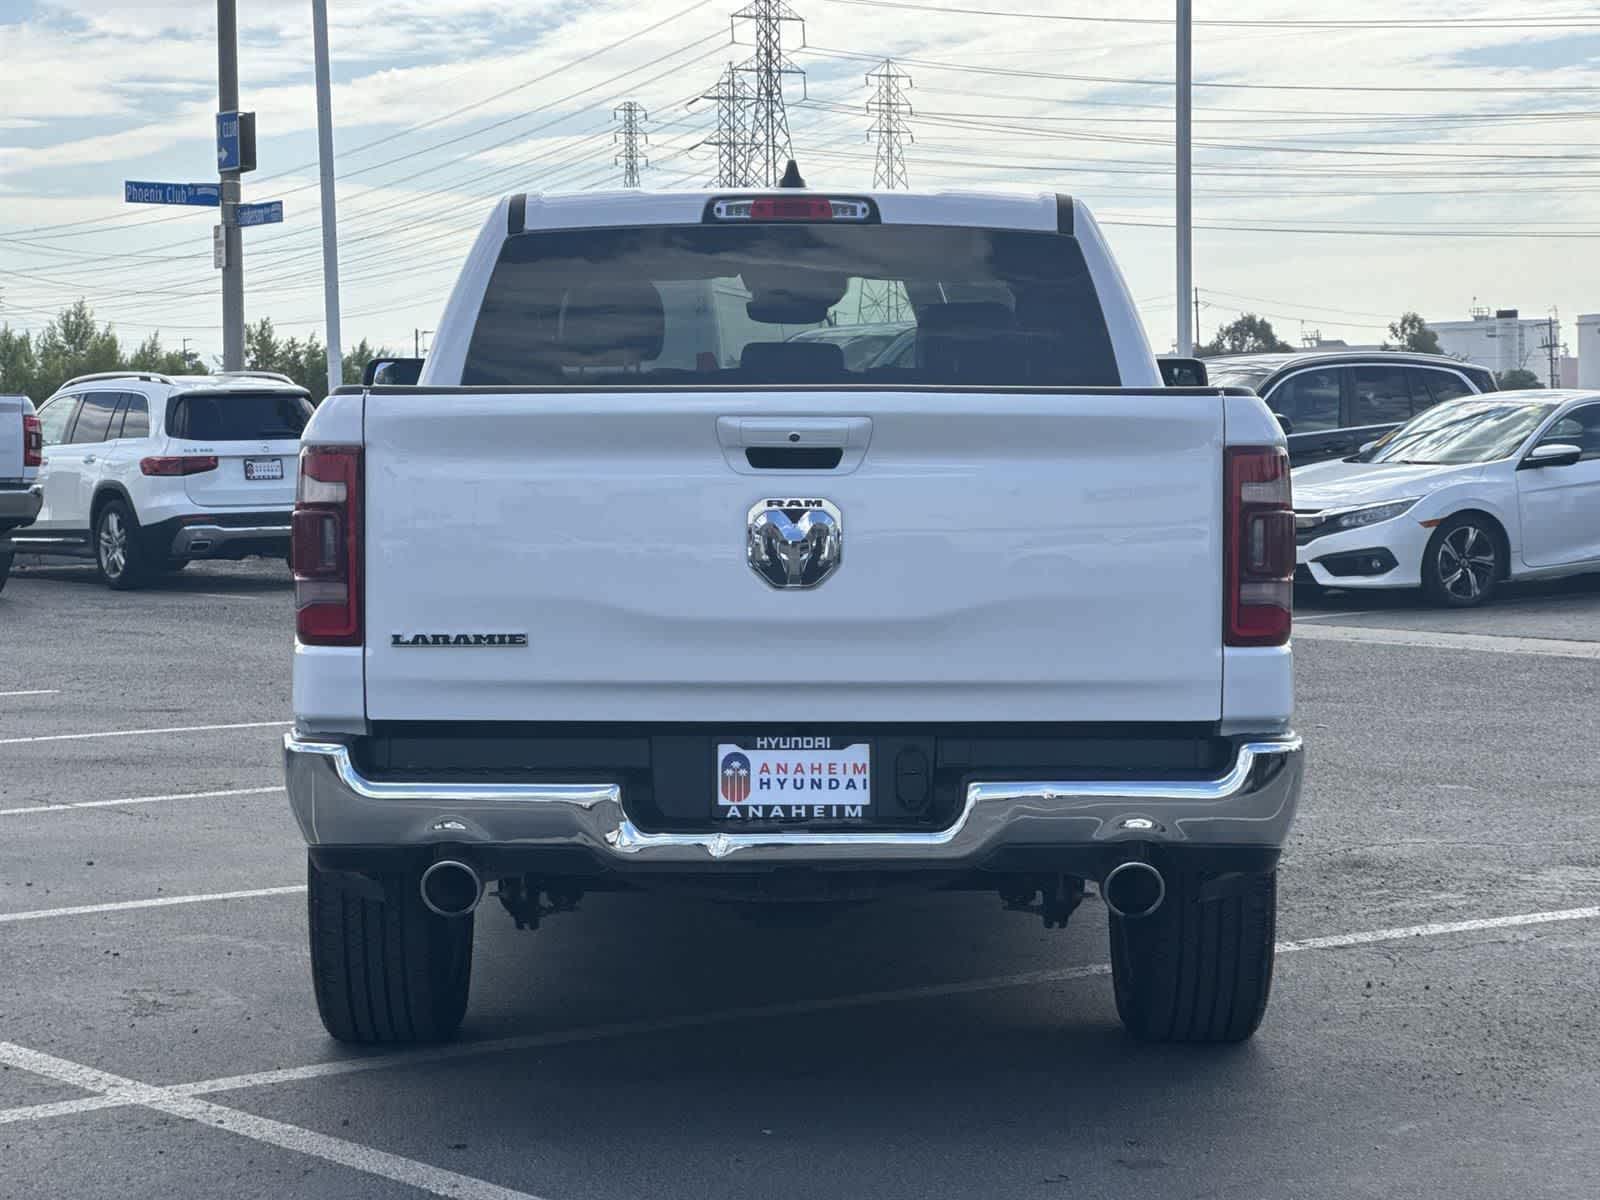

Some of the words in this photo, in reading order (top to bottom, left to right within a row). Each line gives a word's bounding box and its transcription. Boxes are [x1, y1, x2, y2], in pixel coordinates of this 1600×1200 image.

[127, 184, 163, 202] Phoenix
[166, 185, 187, 203] Club
[766, 499, 823, 508] RAM
[391, 633, 528, 647] LARAMIE
[756, 736, 831, 749] HYUNDAI
[759, 762, 867, 775] ANAHEIM
[759, 777, 867, 790] HYUNDAI
[726, 805, 863, 818] ANAHEIM
